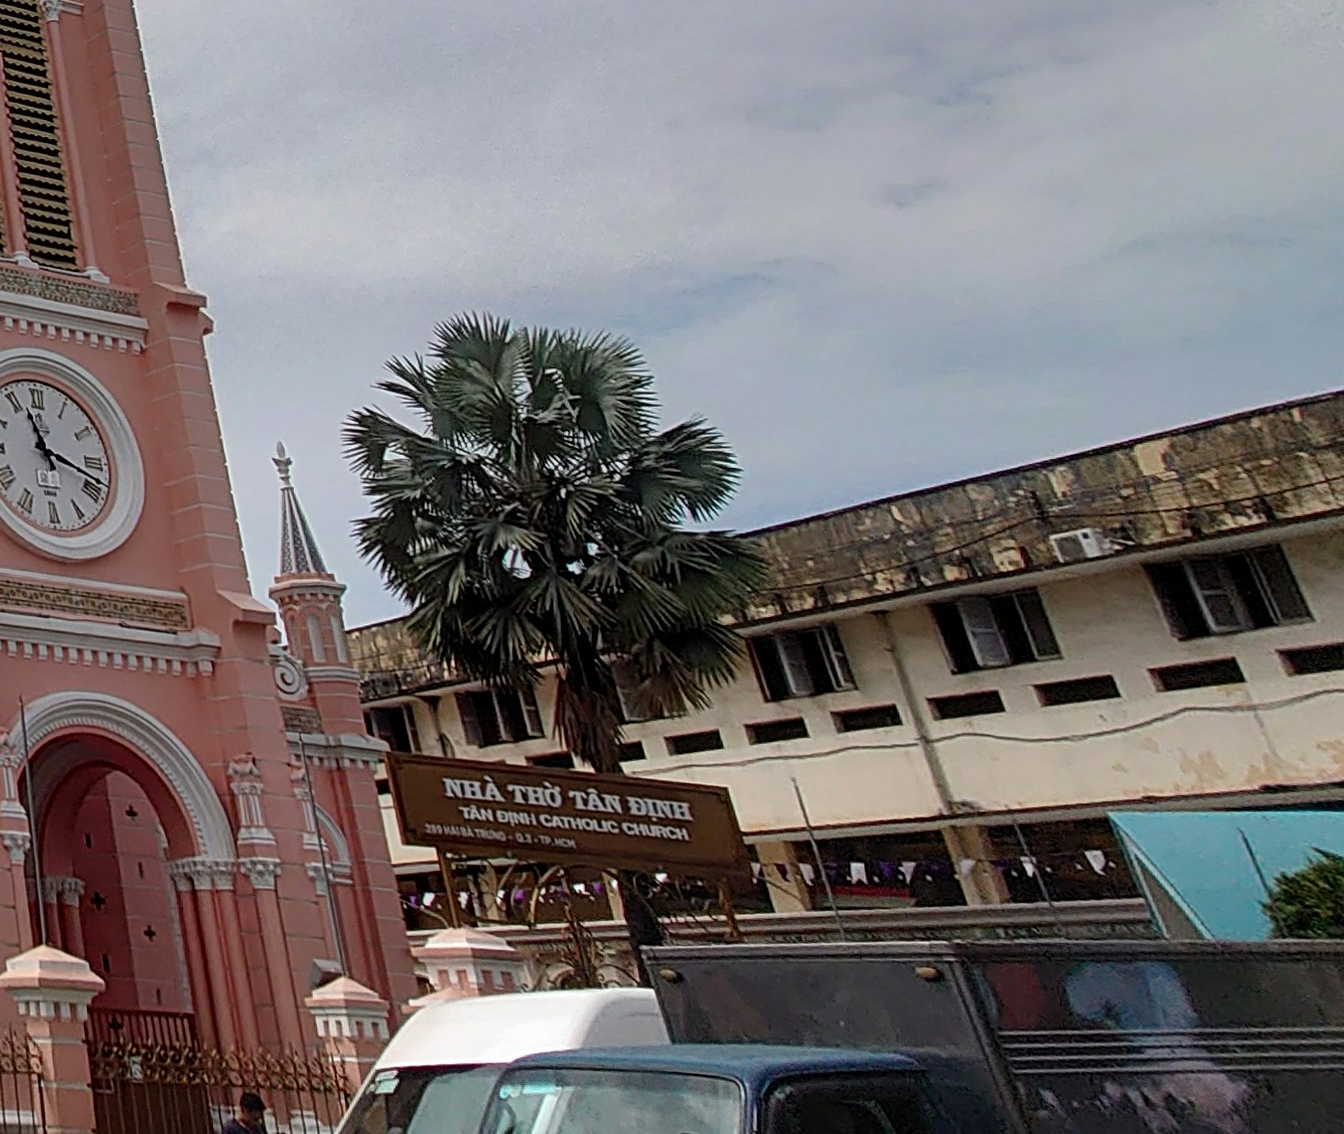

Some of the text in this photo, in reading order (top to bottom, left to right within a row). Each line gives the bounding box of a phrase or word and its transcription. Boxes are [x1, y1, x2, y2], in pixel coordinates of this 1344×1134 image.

[442, 775, 694, 823] NHÀ THỜ TÂN ĐỊNH
[459, 804, 690, 841] TÂN ĐỊNH CATHOLIC CHURCH
